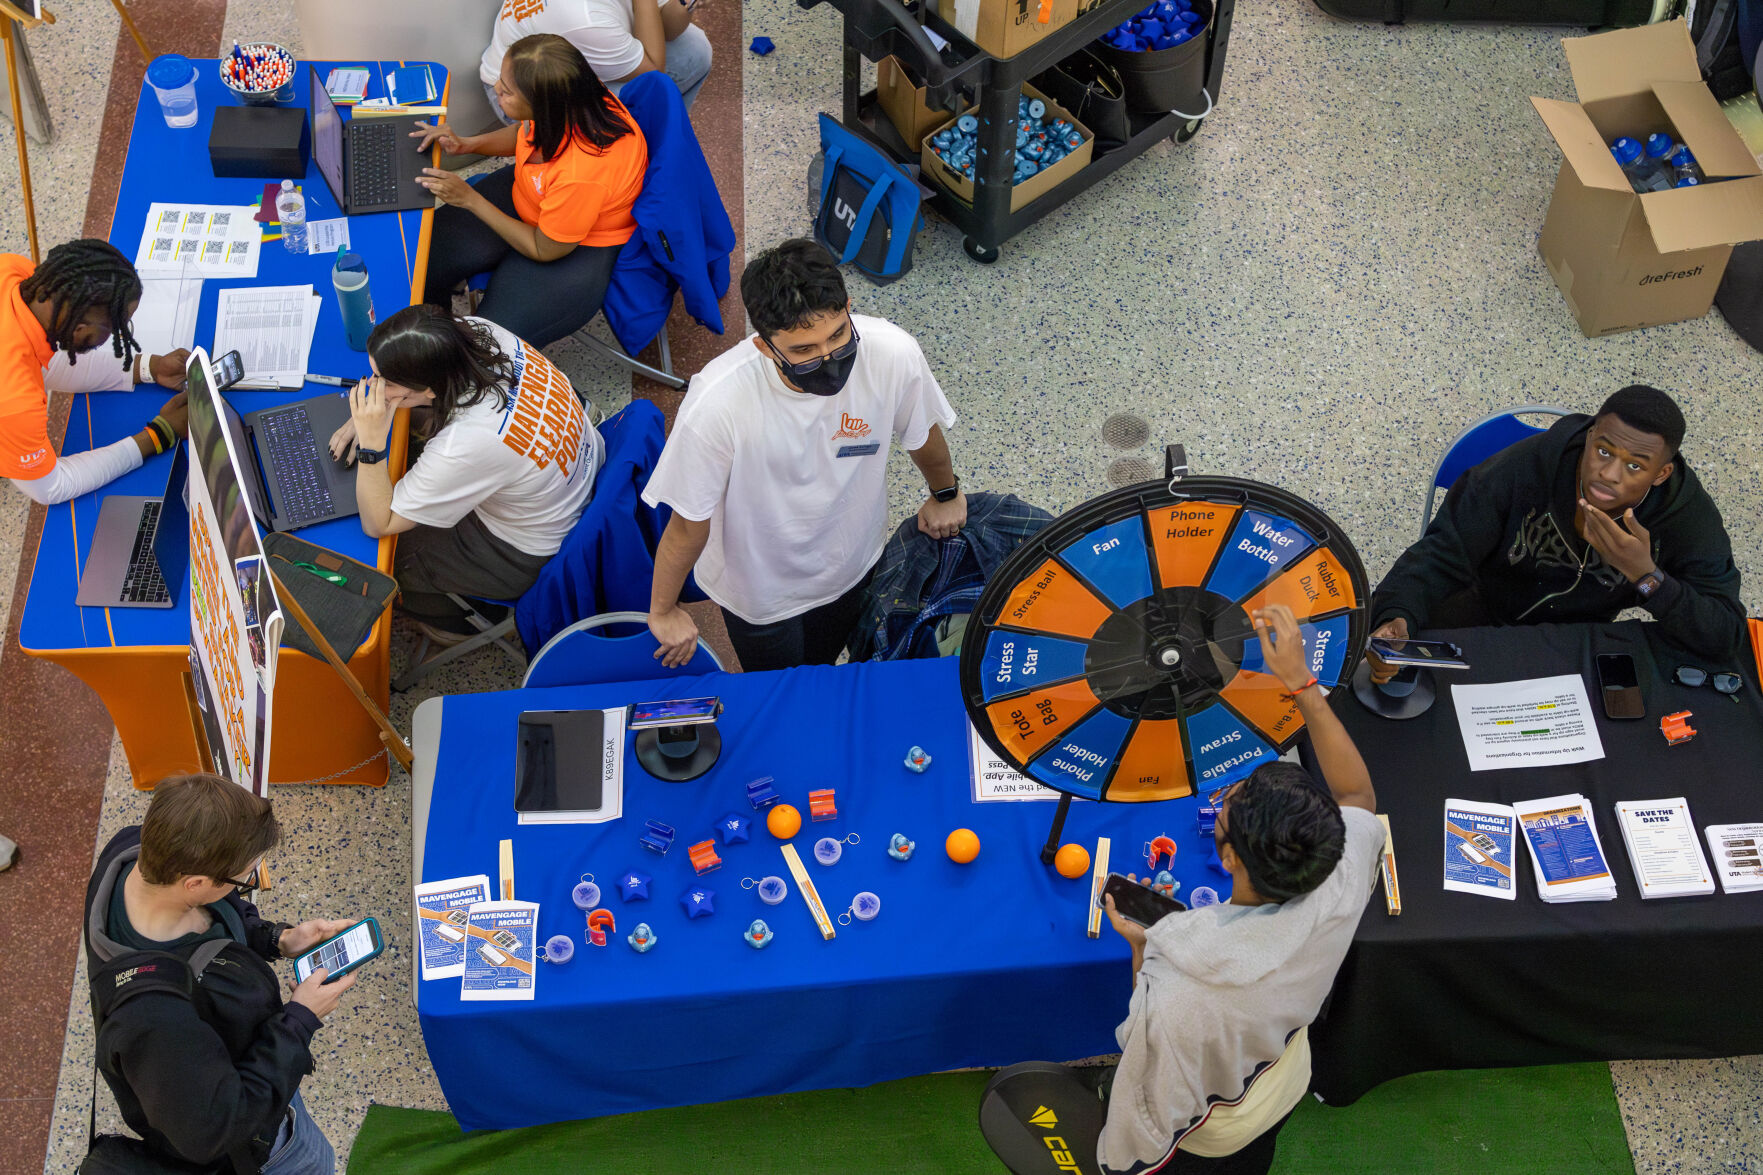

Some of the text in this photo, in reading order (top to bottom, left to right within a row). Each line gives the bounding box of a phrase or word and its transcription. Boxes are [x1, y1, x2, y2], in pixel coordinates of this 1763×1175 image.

[1016, 13, 1028, 26] UP
[834, 196, 856, 232] UT
[506, 392, 516, 413] ASK
[1170, 510, 1215, 521] Phone
[1166, 526, 1214, 538] Holder
[1252, 520, 1294, 548] Water
[1092, 536, 1120, 556] Fan
[1238, 538, 1278, 564] Bottle
[1300, 576, 1319, 602] Duck
[1316, 560, 1340, 598] Rubber
[1012, 570, 1057, 618] Stress Ball
[996, 642, 1014, 682] Stress
[1022, 648, 1038, 674] Star
[1312, 630, 1332, 672] Stress
[1036, 698, 1058, 726] Bag
[1010, 709, 1034, 740] Tote
[1272, 715, 1292, 732] Ball
[1200, 730, 1242, 754] Straw
[605, 738, 614, 781] K89EGAK
[988, 762, 1008, 770] Pass
[1063, 743, 1108, 768] Holder
[1202, 746, 1263, 778] Portable
[1052, 758, 1094, 782] Phone
[1138, 776, 1160, 784] Fan
[1449, 812, 1506, 824] MAVENGAGE
[1476, 824, 1510, 834] MOBILE
[1642, 816, 1670, 824] DATES
[420, 888, 478, 904] MAVENGAGE
[450, 896, 484, 906] MOBILE
[470, 912, 528, 920] MAVENGAGE
[498, 918, 532, 926] MOBILE
[116, 968, 138, 982] MOBILE
